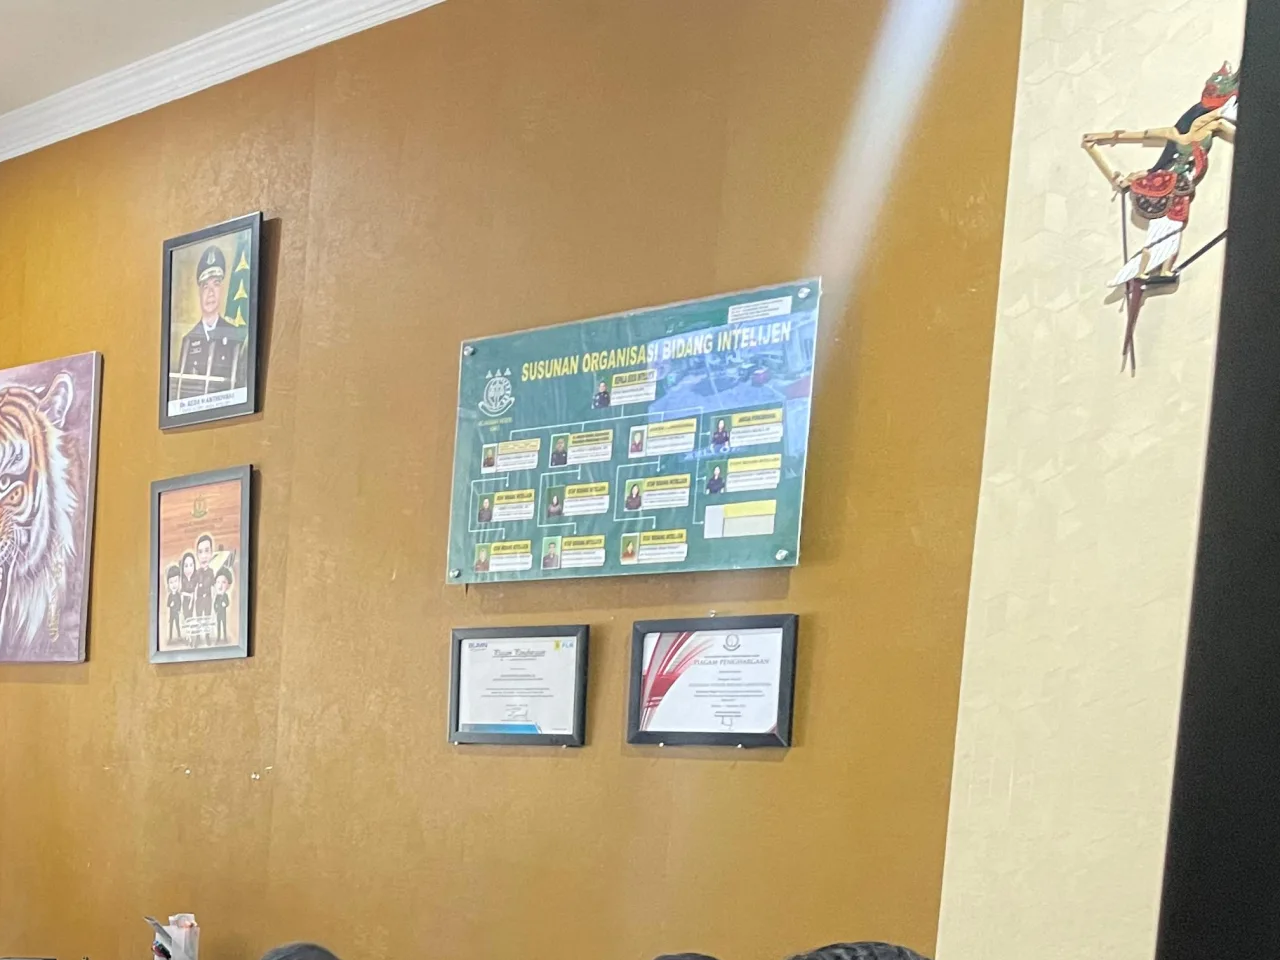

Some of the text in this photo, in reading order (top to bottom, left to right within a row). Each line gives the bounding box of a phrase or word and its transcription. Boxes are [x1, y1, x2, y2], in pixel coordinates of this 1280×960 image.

[521, 355, 579, 382] SUSUNAN
[582, 342, 659, 373] ORGANISASI
[662, 333, 713, 360] BIDANG
[717, 321, 792, 351] INTELIJEN
